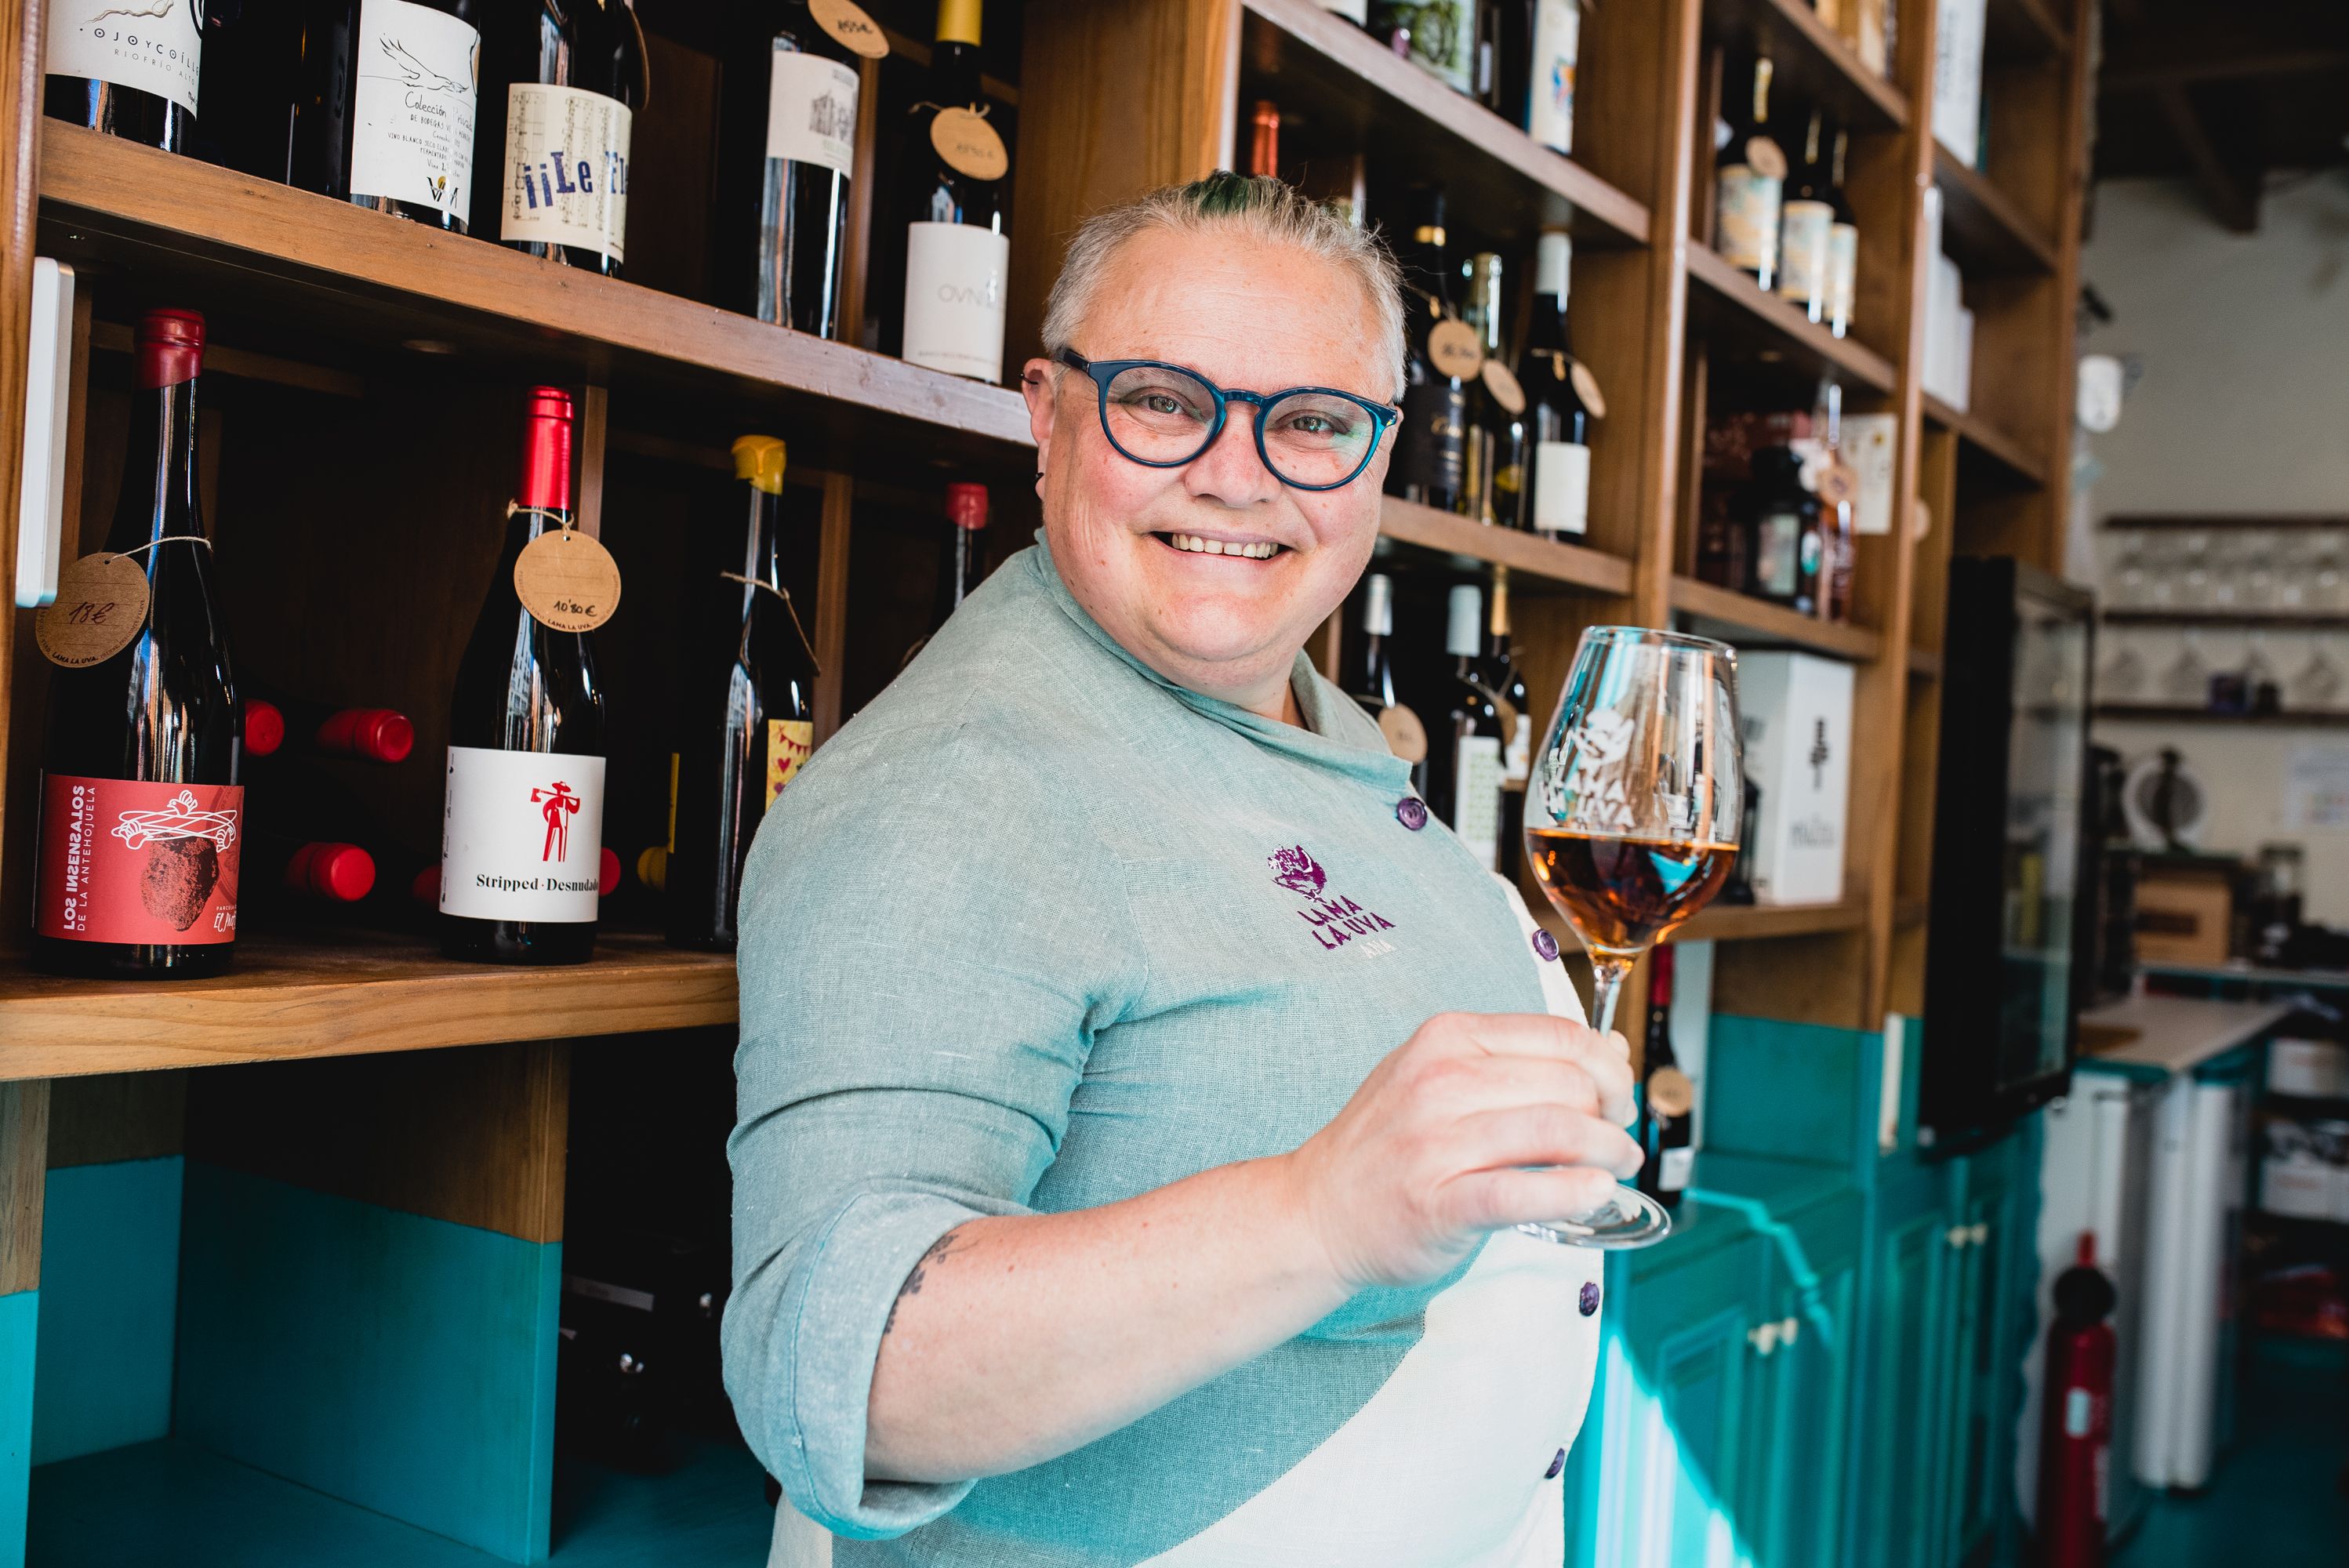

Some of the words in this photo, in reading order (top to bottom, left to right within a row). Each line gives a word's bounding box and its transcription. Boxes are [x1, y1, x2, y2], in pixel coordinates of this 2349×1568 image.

[405, 91, 447, 118] Colección
[421, 116, 445, 130] BODEGAS
[403, 135, 422, 146] BLANCO
[547, 619, 565, 630] LAMA
[53, 652, 69, 663] LAMA
[66, 785, 85, 892] INSENSATOS
[81, 786, 96, 884] ANTEHOJUELA
[476, 873, 539, 892] Stripped
[80, 891, 88, 907] LA
[64, 898, 77, 930] LOS
[1297, 895, 1363, 926] LAMA
[78, 914, 86, 931] DE
[1312, 924, 1351, 950] LA
[1342, 912, 1396, 935] UVA
